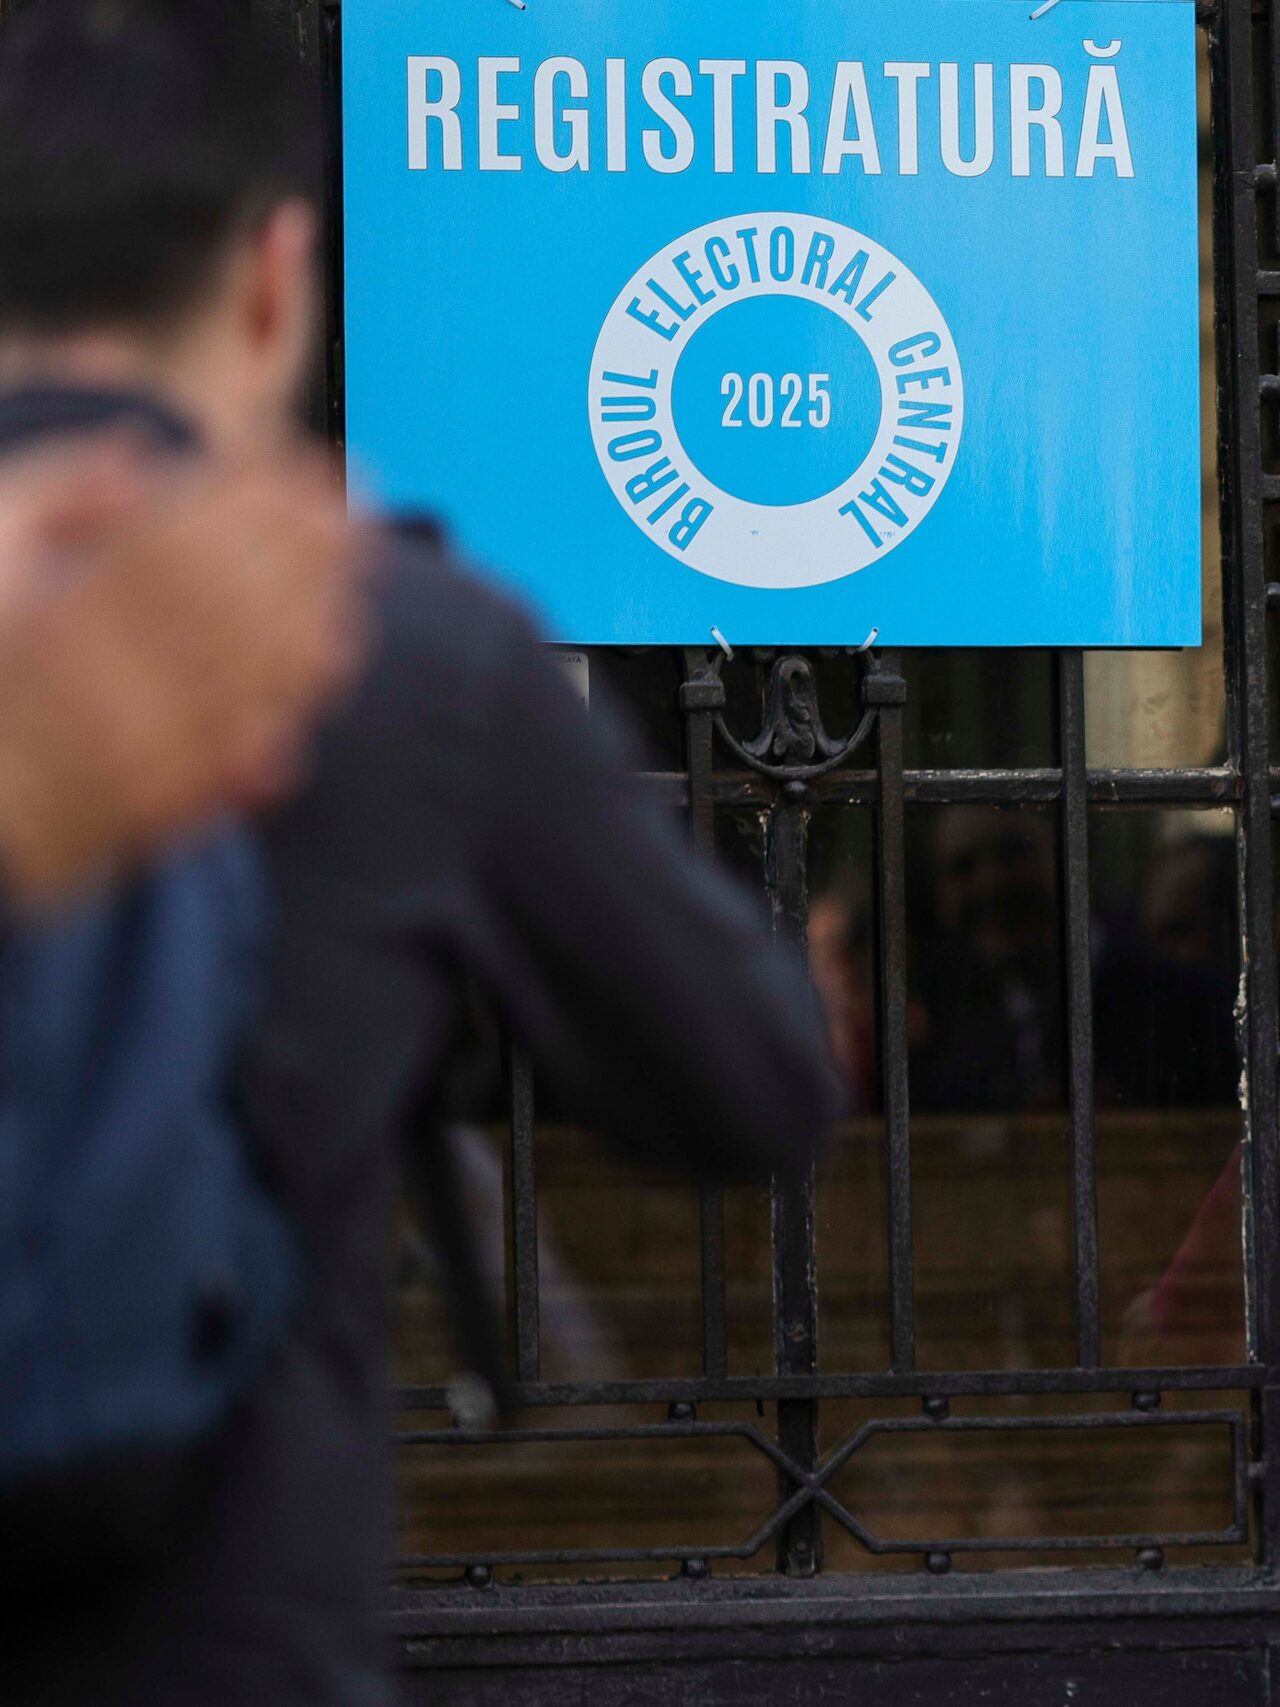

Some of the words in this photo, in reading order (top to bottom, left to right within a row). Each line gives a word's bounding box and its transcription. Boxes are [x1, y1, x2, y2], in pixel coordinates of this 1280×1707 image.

[406, 39, 1136, 179] REGISTRATURĂ
[624, 225, 897, 342] ELECTORAL
[600, 368, 715, 552] BIROUL
[720, 372, 832, 428] 2025
[837, 330, 953, 549] CENTRAL
